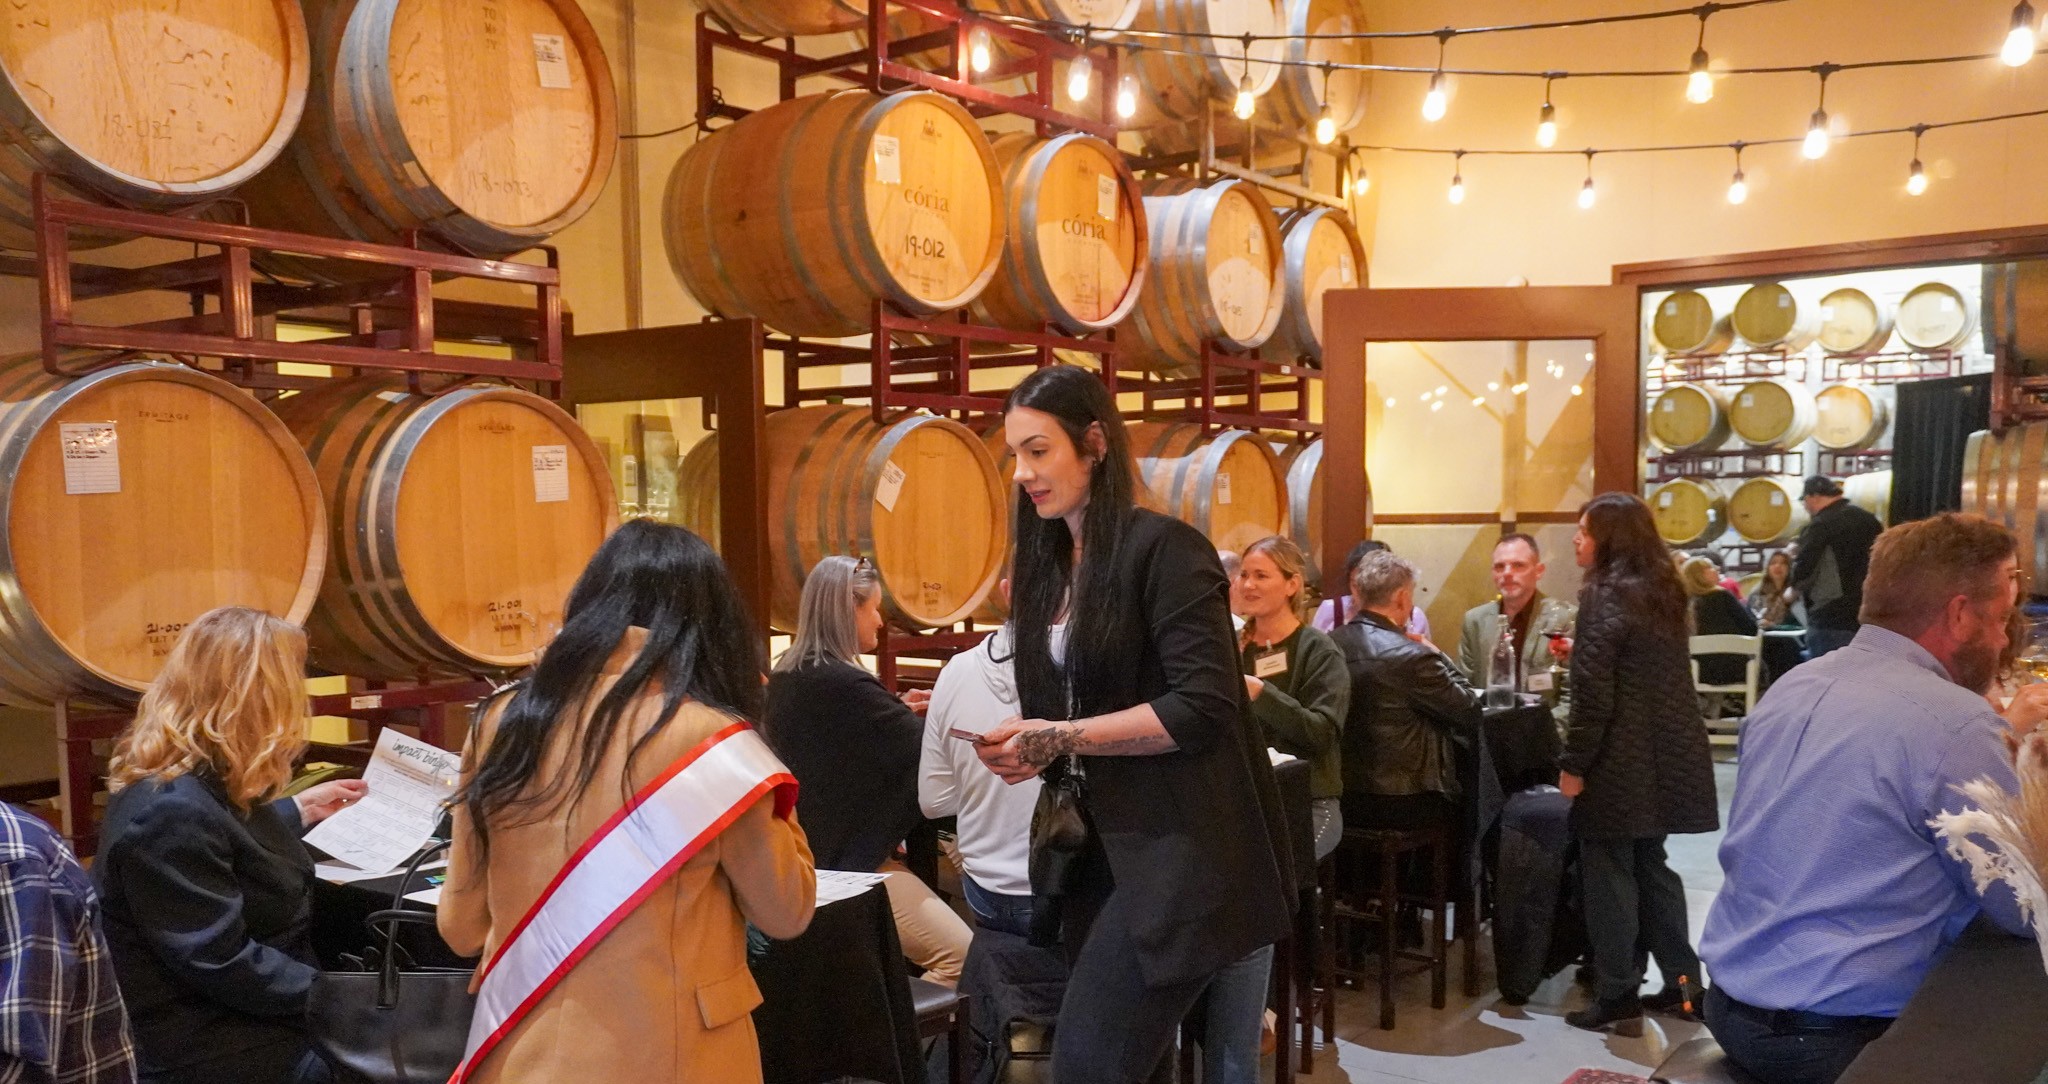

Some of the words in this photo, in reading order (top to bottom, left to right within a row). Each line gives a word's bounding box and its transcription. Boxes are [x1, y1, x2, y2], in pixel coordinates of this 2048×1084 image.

[904, 185, 949, 212] cória
[1062, 214, 1106, 240] cória
[905, 234, 945, 259] 19-012
[392, 738, 426, 760] impact
